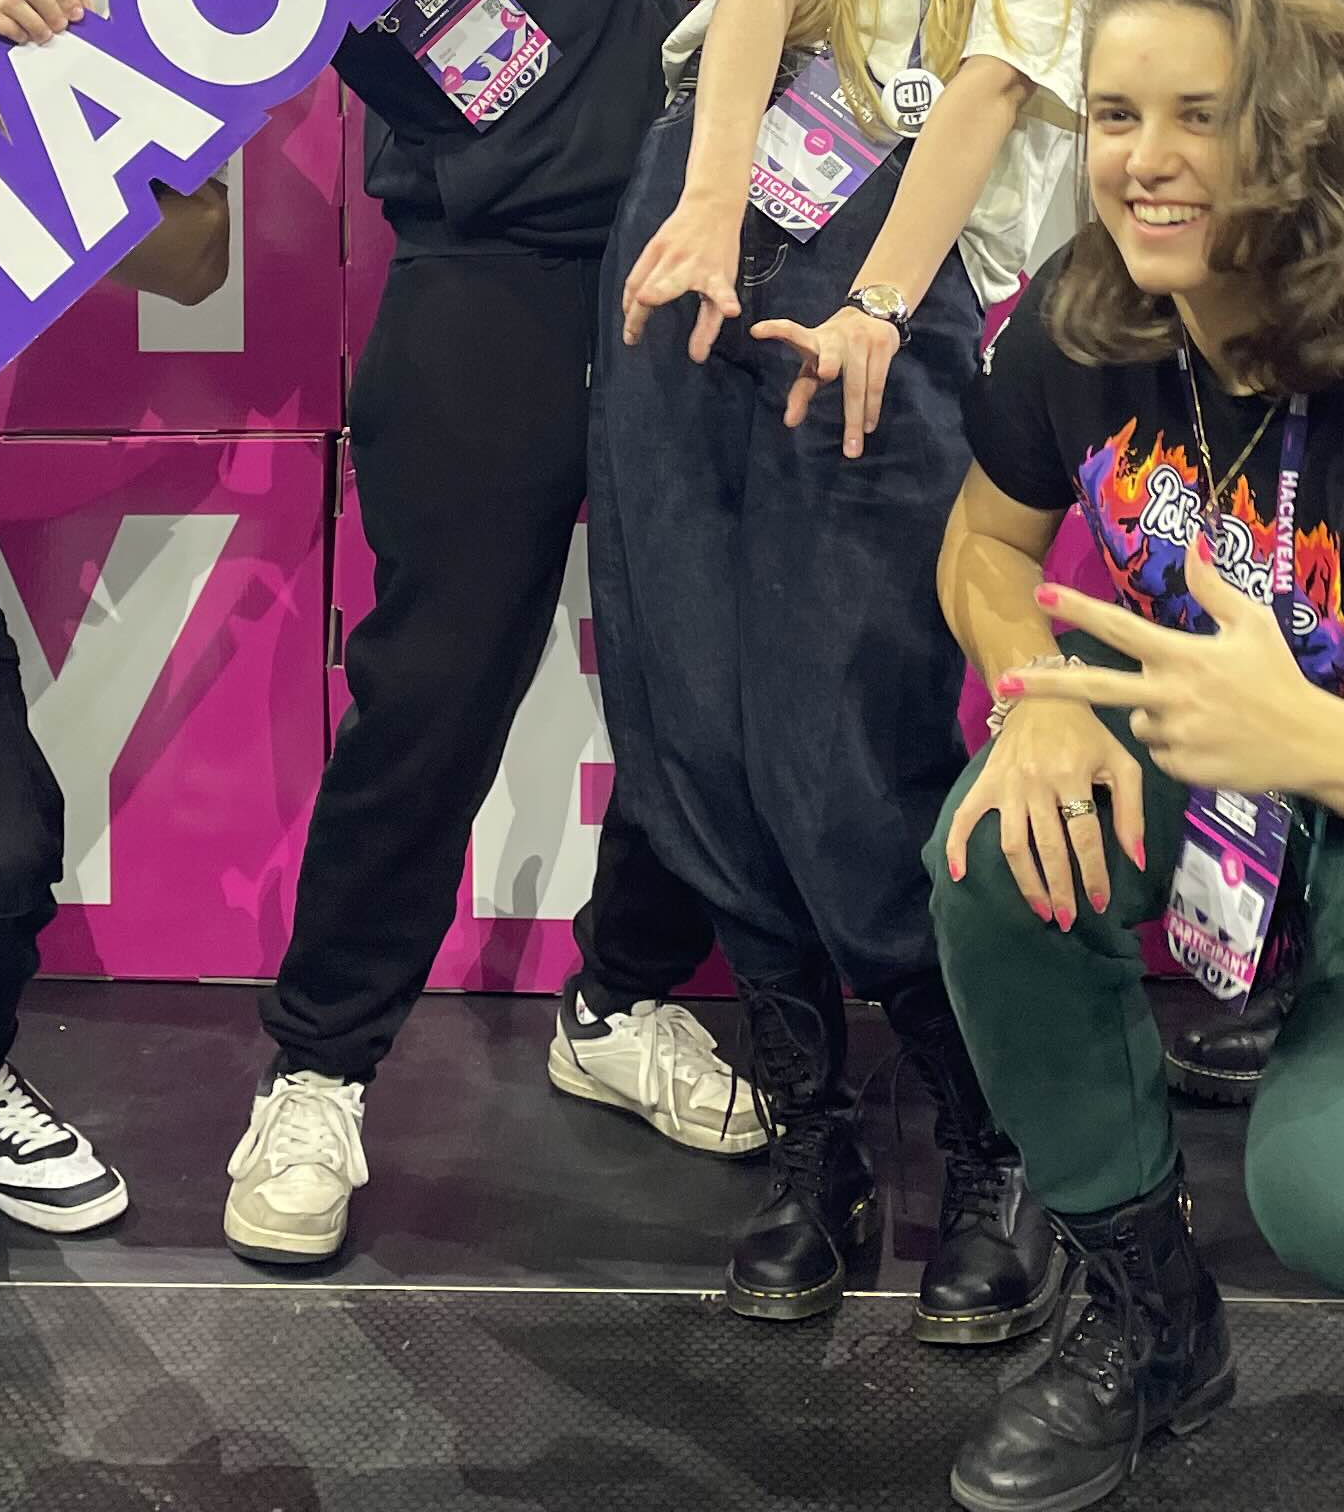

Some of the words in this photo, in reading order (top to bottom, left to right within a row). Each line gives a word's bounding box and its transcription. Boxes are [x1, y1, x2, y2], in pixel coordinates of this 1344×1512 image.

[471, 35, 541, 117] PARTICIPANT
[751, 165, 824, 220] RTICIPANT
[1273, 469, 1300, 595] HACKYEAH
[1168, 915, 1249, 979] PARTICIPANT
